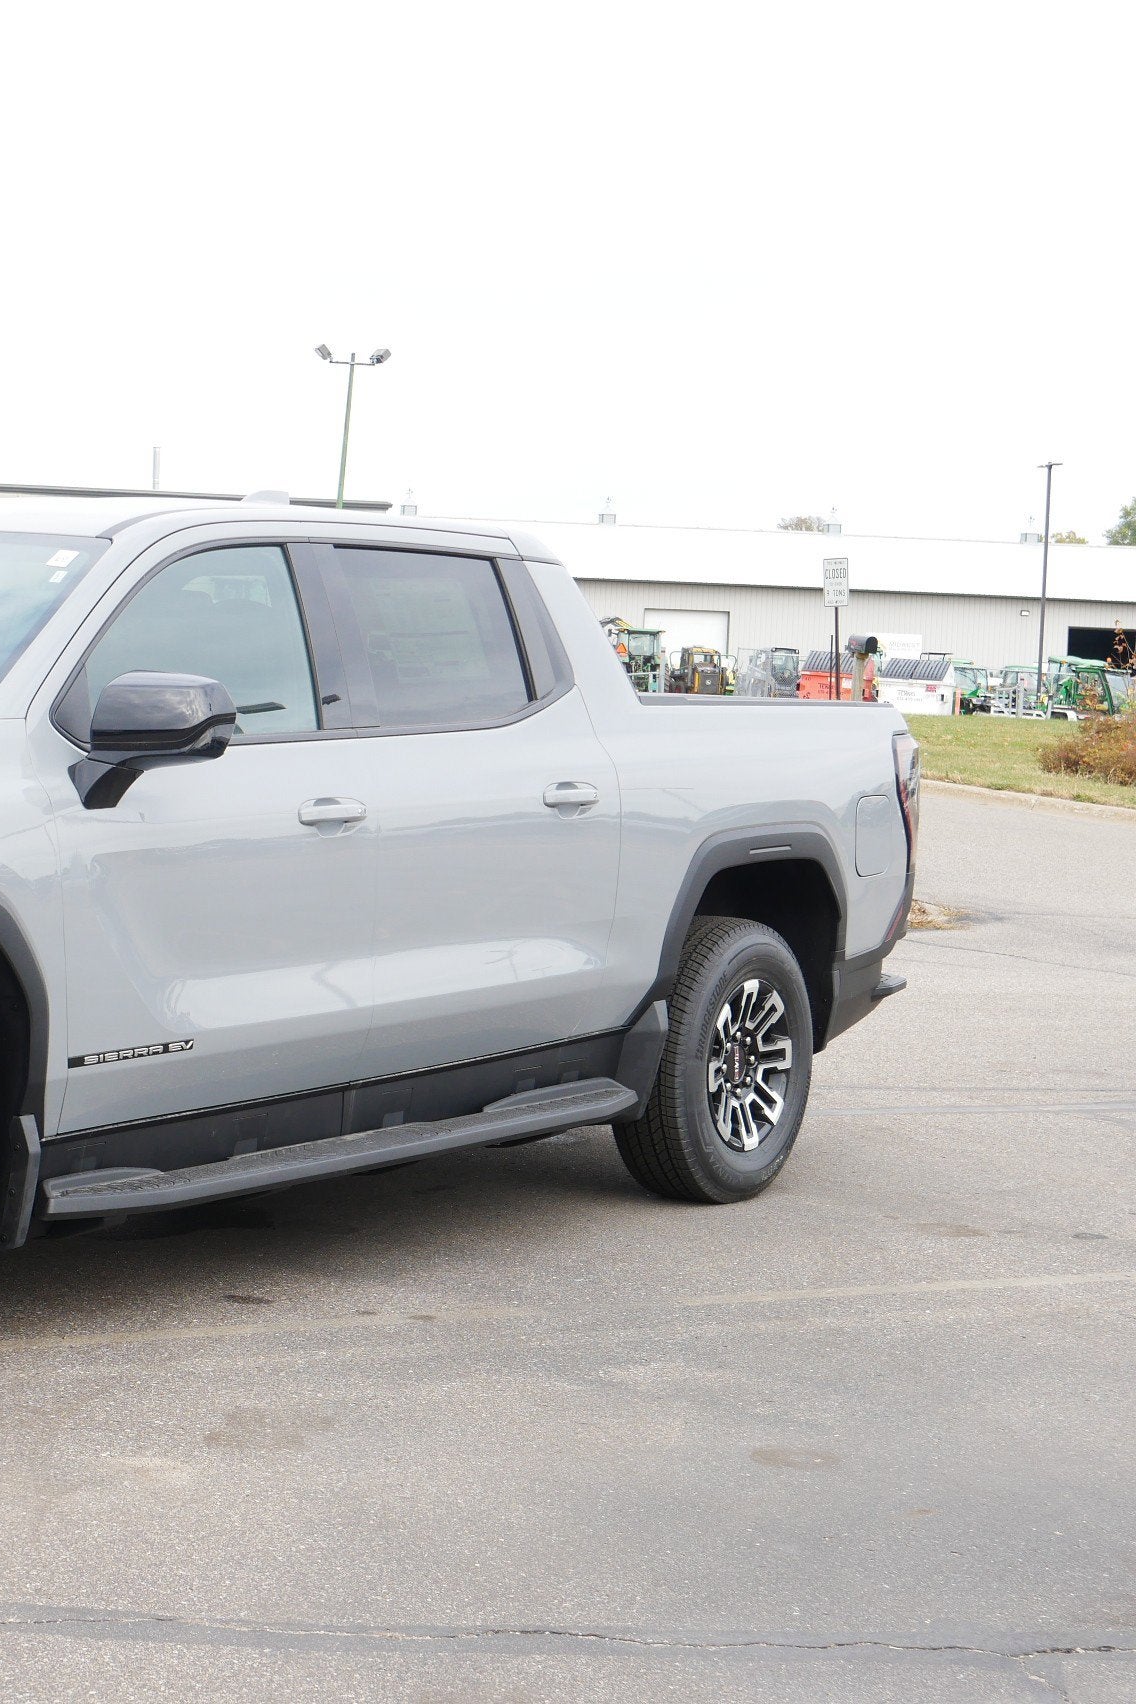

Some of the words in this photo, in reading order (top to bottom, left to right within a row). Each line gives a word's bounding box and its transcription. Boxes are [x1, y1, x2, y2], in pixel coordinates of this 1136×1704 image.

[824, 567, 847, 580] CLOSED
[83, 1045, 164, 1065] SIERRA
[168, 1040, 195, 1053] EV
